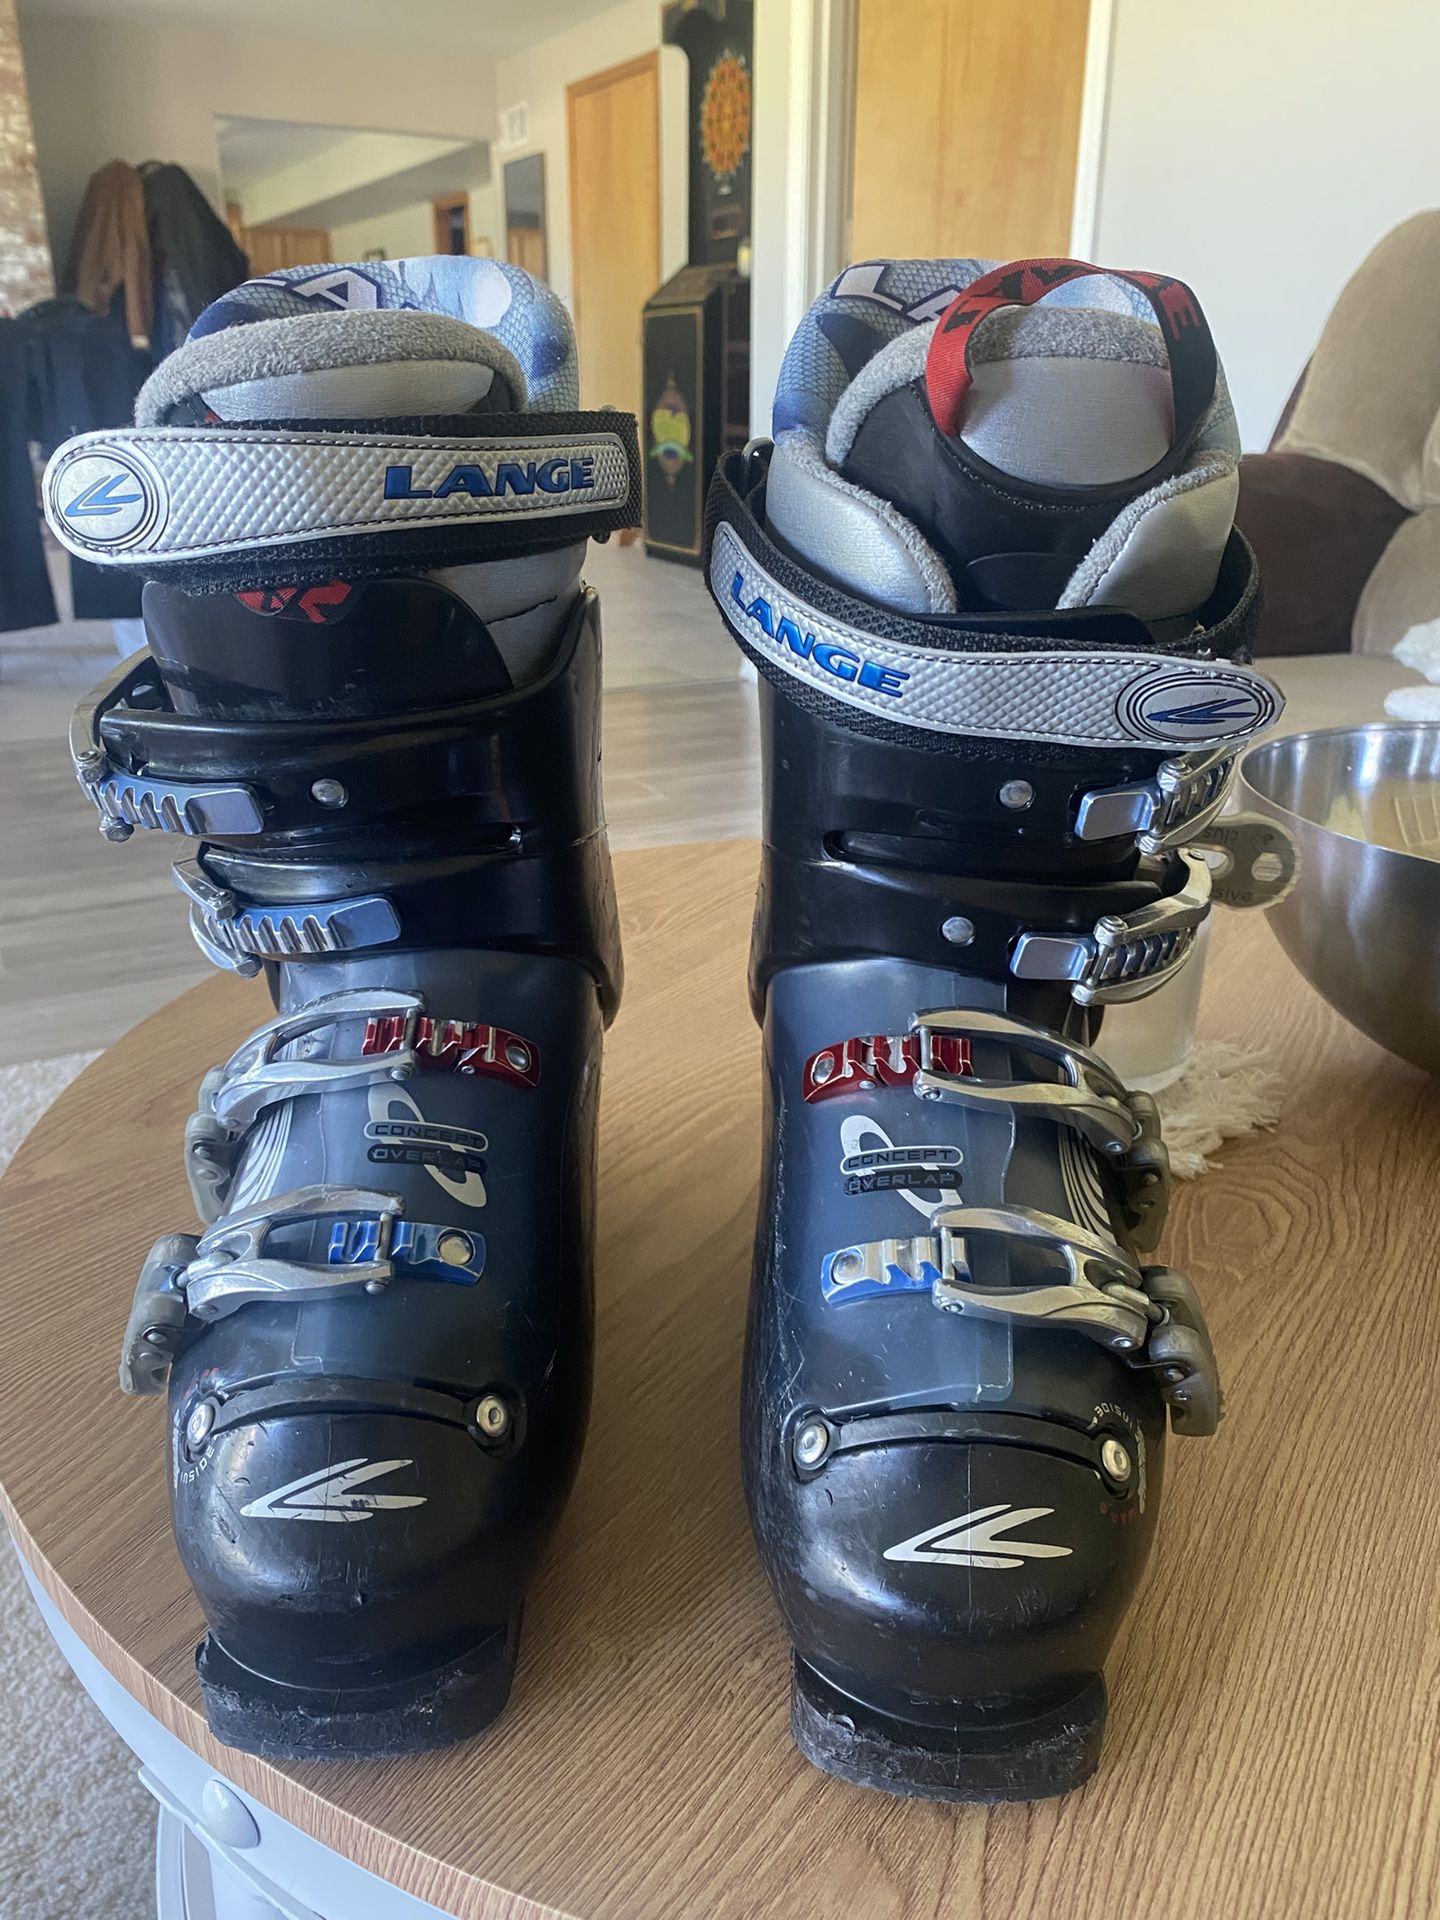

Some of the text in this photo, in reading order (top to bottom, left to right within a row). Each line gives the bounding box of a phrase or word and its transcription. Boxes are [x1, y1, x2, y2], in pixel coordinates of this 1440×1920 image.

[384, 457, 595, 500] LANGE
[731, 571, 911, 698] LANGE
[374, 1124, 480, 1148] CONCEPT
[372, 1147, 482, 1171] OVERLAP
[847, 1149, 954, 1168] CONCEPT
[848, 1173, 955, 1192] OVERLAP
[1094, 1402, 1133, 1429] INSIDE
[180, 1445, 215, 1484] INSIDE
